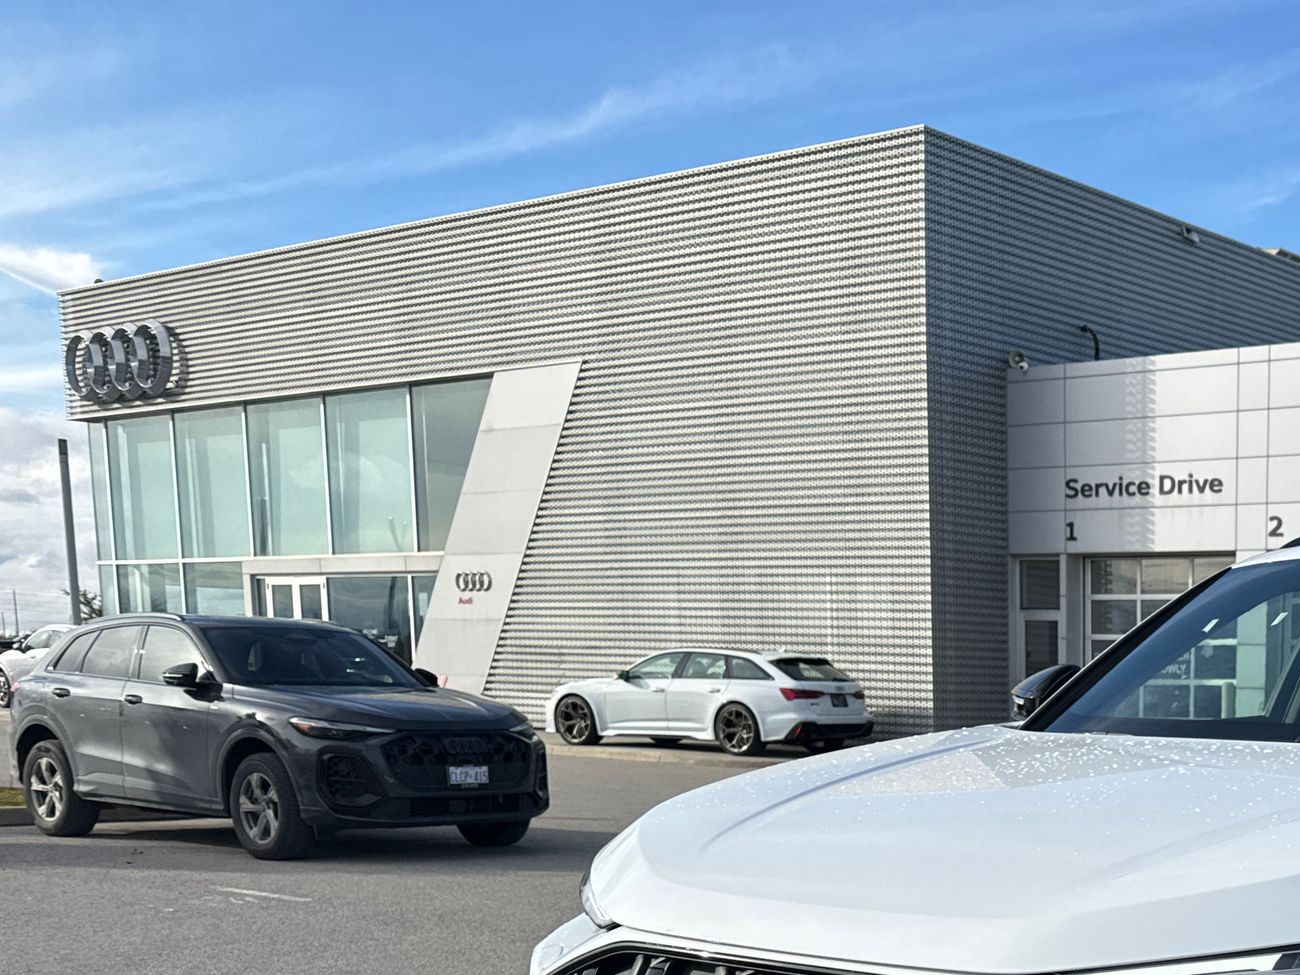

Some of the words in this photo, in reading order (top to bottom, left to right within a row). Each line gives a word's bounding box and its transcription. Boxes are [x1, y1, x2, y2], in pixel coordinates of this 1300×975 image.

[1065, 476, 1151, 499] Service
[1158, 473, 1224, 496] Drive
[1066, 521, 1078, 541] 1
[1268, 516, 1284, 538] 2
[458, 597, 473, 605] Audi
